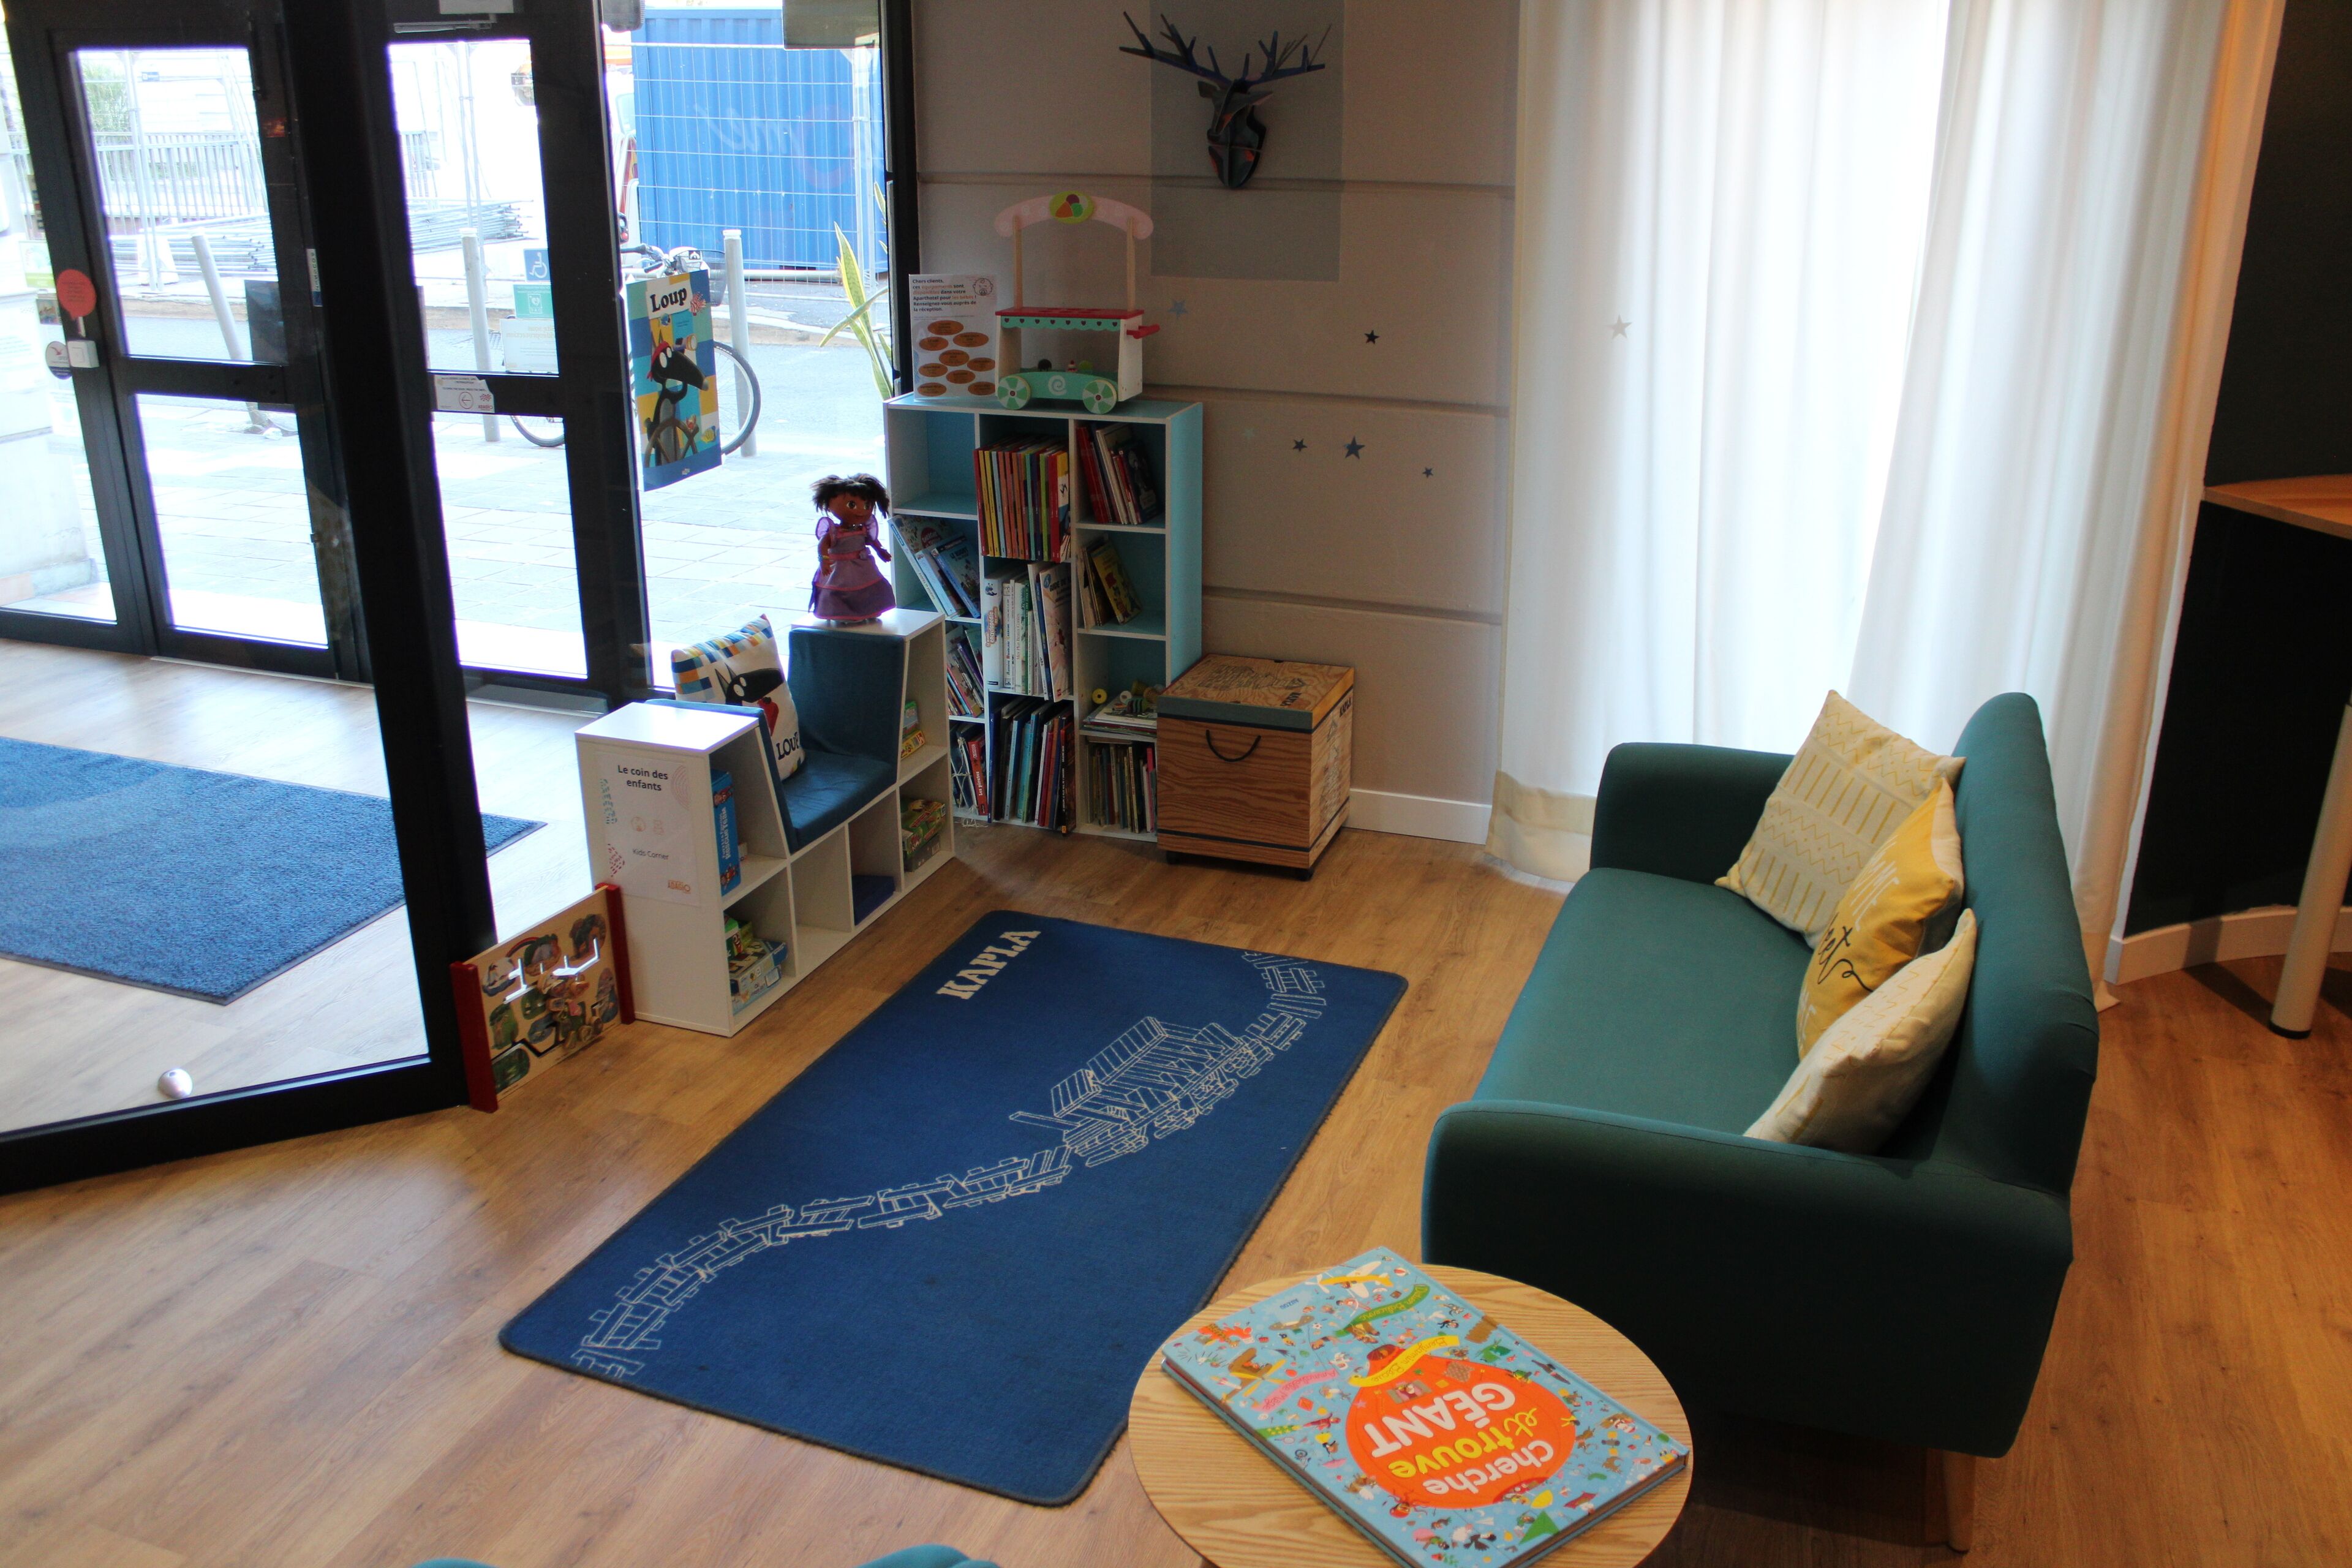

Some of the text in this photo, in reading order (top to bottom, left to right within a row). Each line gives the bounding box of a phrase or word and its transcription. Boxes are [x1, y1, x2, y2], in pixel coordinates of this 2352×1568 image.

[650, 288, 687, 312] Loup
[617, 764, 668, 780] Le coin des
[627, 780, 662, 791] enfants
[633, 848, 669, 861] Kids Corner
[936, 930, 1041, 1000] KAPLA
[1280, 1298, 1299, 1310] AUZOU
[1401, 1336, 1448, 1366] Benjamin
[1364, 1382, 1516, 1458] GÉANT
[1389, 1408, 1538, 1478] et trouve
[1422, 1440, 1554, 1494] Cherche
